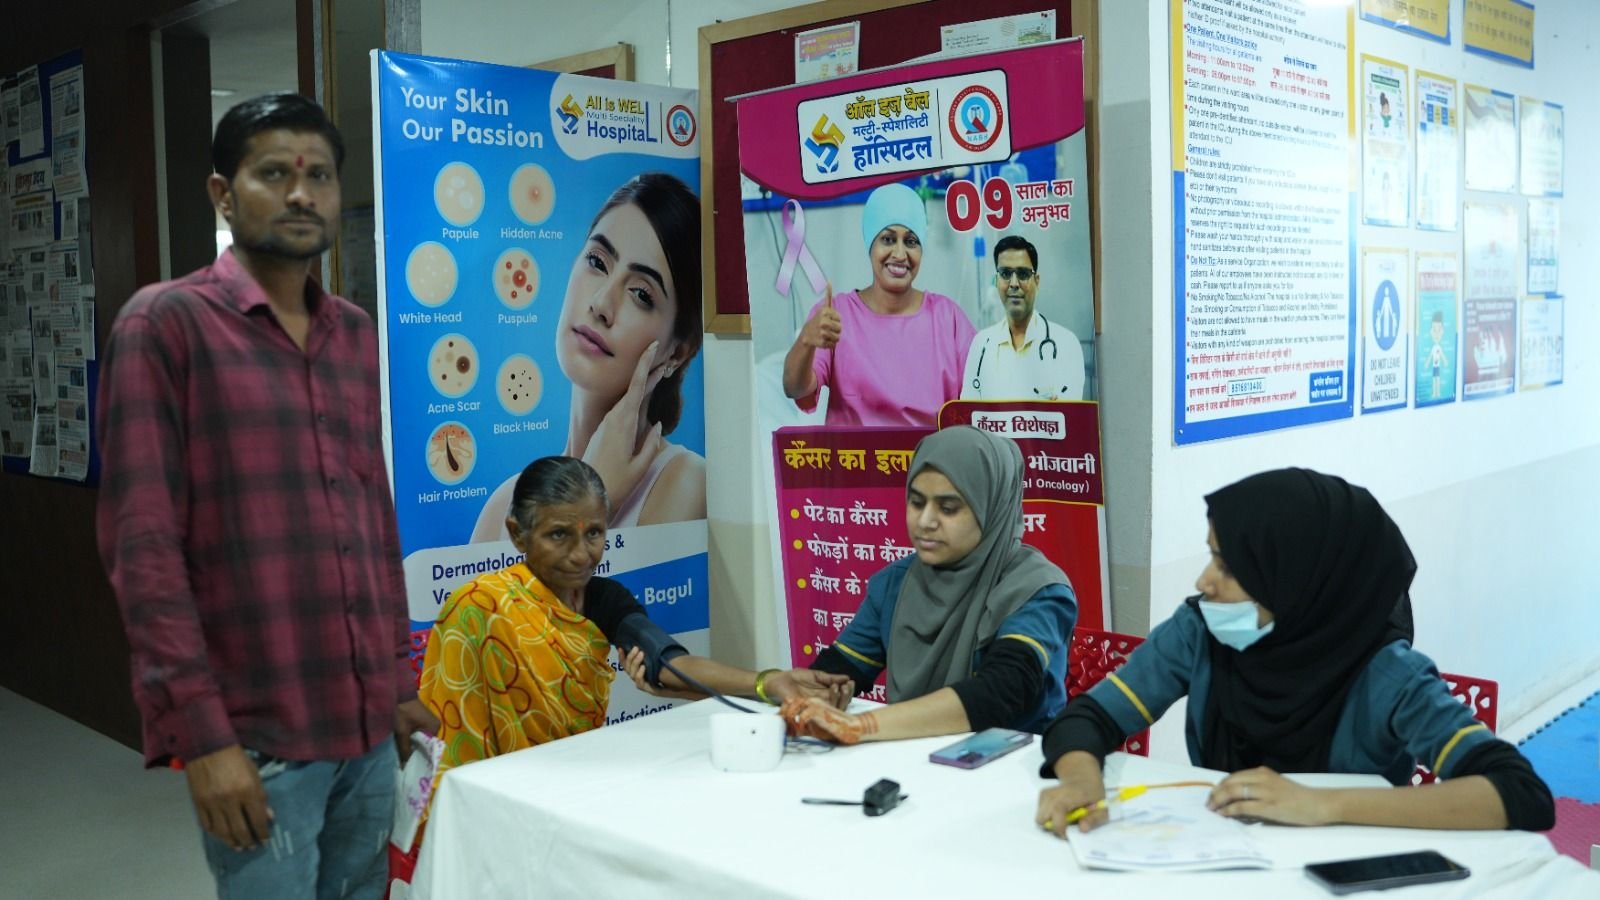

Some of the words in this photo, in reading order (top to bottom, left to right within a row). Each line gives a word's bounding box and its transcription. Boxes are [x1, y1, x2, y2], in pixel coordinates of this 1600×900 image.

[401, 86, 447, 111] Your
[455, 88, 509, 116] Skin
[586, 95, 602, 110] All
[845, 95, 876, 120] ऑल
[609, 114, 645, 125] Speciality
[402, 119, 443, 141] Our
[451, 119, 544, 149] Passion
[851, 135, 933, 172] हॉस्पिटल
[1015, 181, 1048, 200] साल
[1052, 180, 1073, 197] का
[945, 176, 1013, 232] 09
[1022, 204, 1070, 228] अनुभव
[442, 228, 479, 240] Papule
[500, 228, 537, 239] Hidden
[538, 229, 563, 240] Acne
[399, 313, 431, 324] White
[433, 312, 462, 323] Head
[498, 313, 538, 326] Puspule
[427, 402, 455, 415] Acne
[456, 400, 481, 413] Scar
[493, 422, 520, 435] Black
[522, 419, 549, 432] Head
[1011, 415, 1060, 437] विशेषज्ञ
[837, 449, 867, 471] का
[874, 449, 916, 475] इला
[1027, 450, 1096, 474] भोजवानी
[418, 491, 441, 504] Hair
[442, 486, 488, 500] Problem
[1036, 478, 1090, 494] Oncology)
[803, 497, 825, 522] पेट
[826, 506, 845, 525] का
[849, 500, 888, 526] कैंसर
[615, 534, 625, 549] &
[853, 543, 875, 561] का
[809, 567, 841, 594] कैंसर
[844, 572, 861, 595] के
[644, 578, 692, 606] Bagul
[812, 608, 828, 627] का
